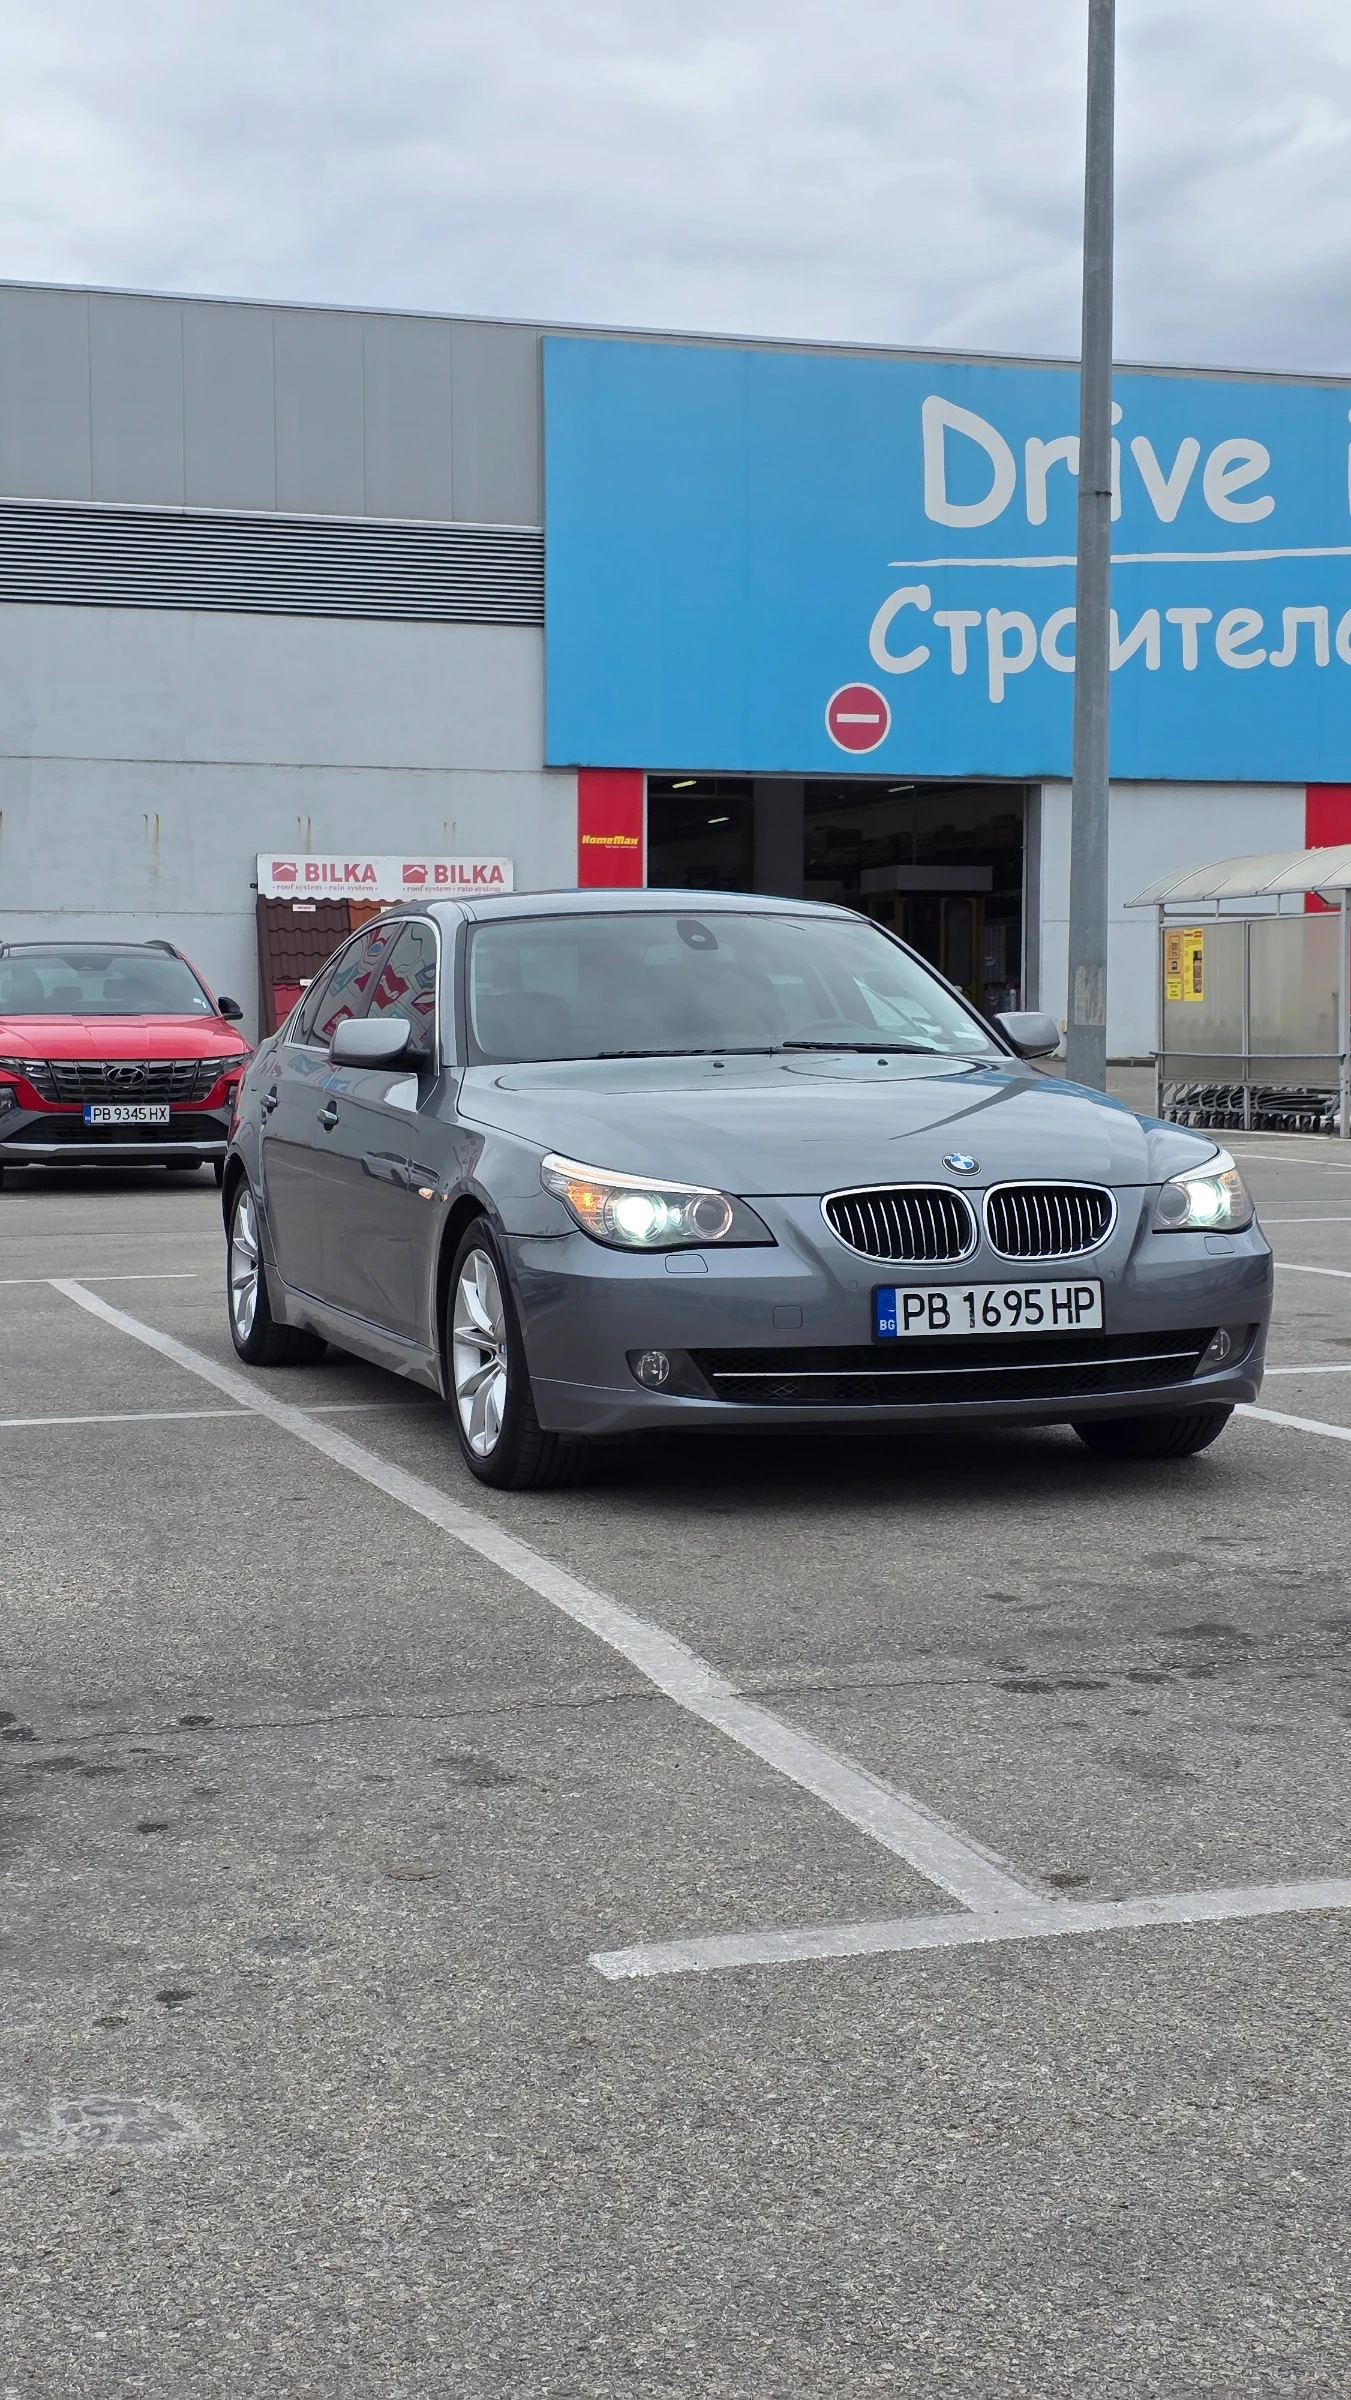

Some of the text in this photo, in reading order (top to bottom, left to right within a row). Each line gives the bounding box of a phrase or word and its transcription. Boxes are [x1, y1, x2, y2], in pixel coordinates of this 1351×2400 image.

[868, 584, 1351, 704] Строител
[305, 863, 377, 882] BILKA
[434, 865, 504, 883] BILKA
[295, 884, 322, 893] system
[347, 884, 374, 893] system
[114, 1107, 147, 1121] 9345
[903, 1287, 1094, 1330] PB 1695 HP
[879, 1319, 895, 1331] BG
